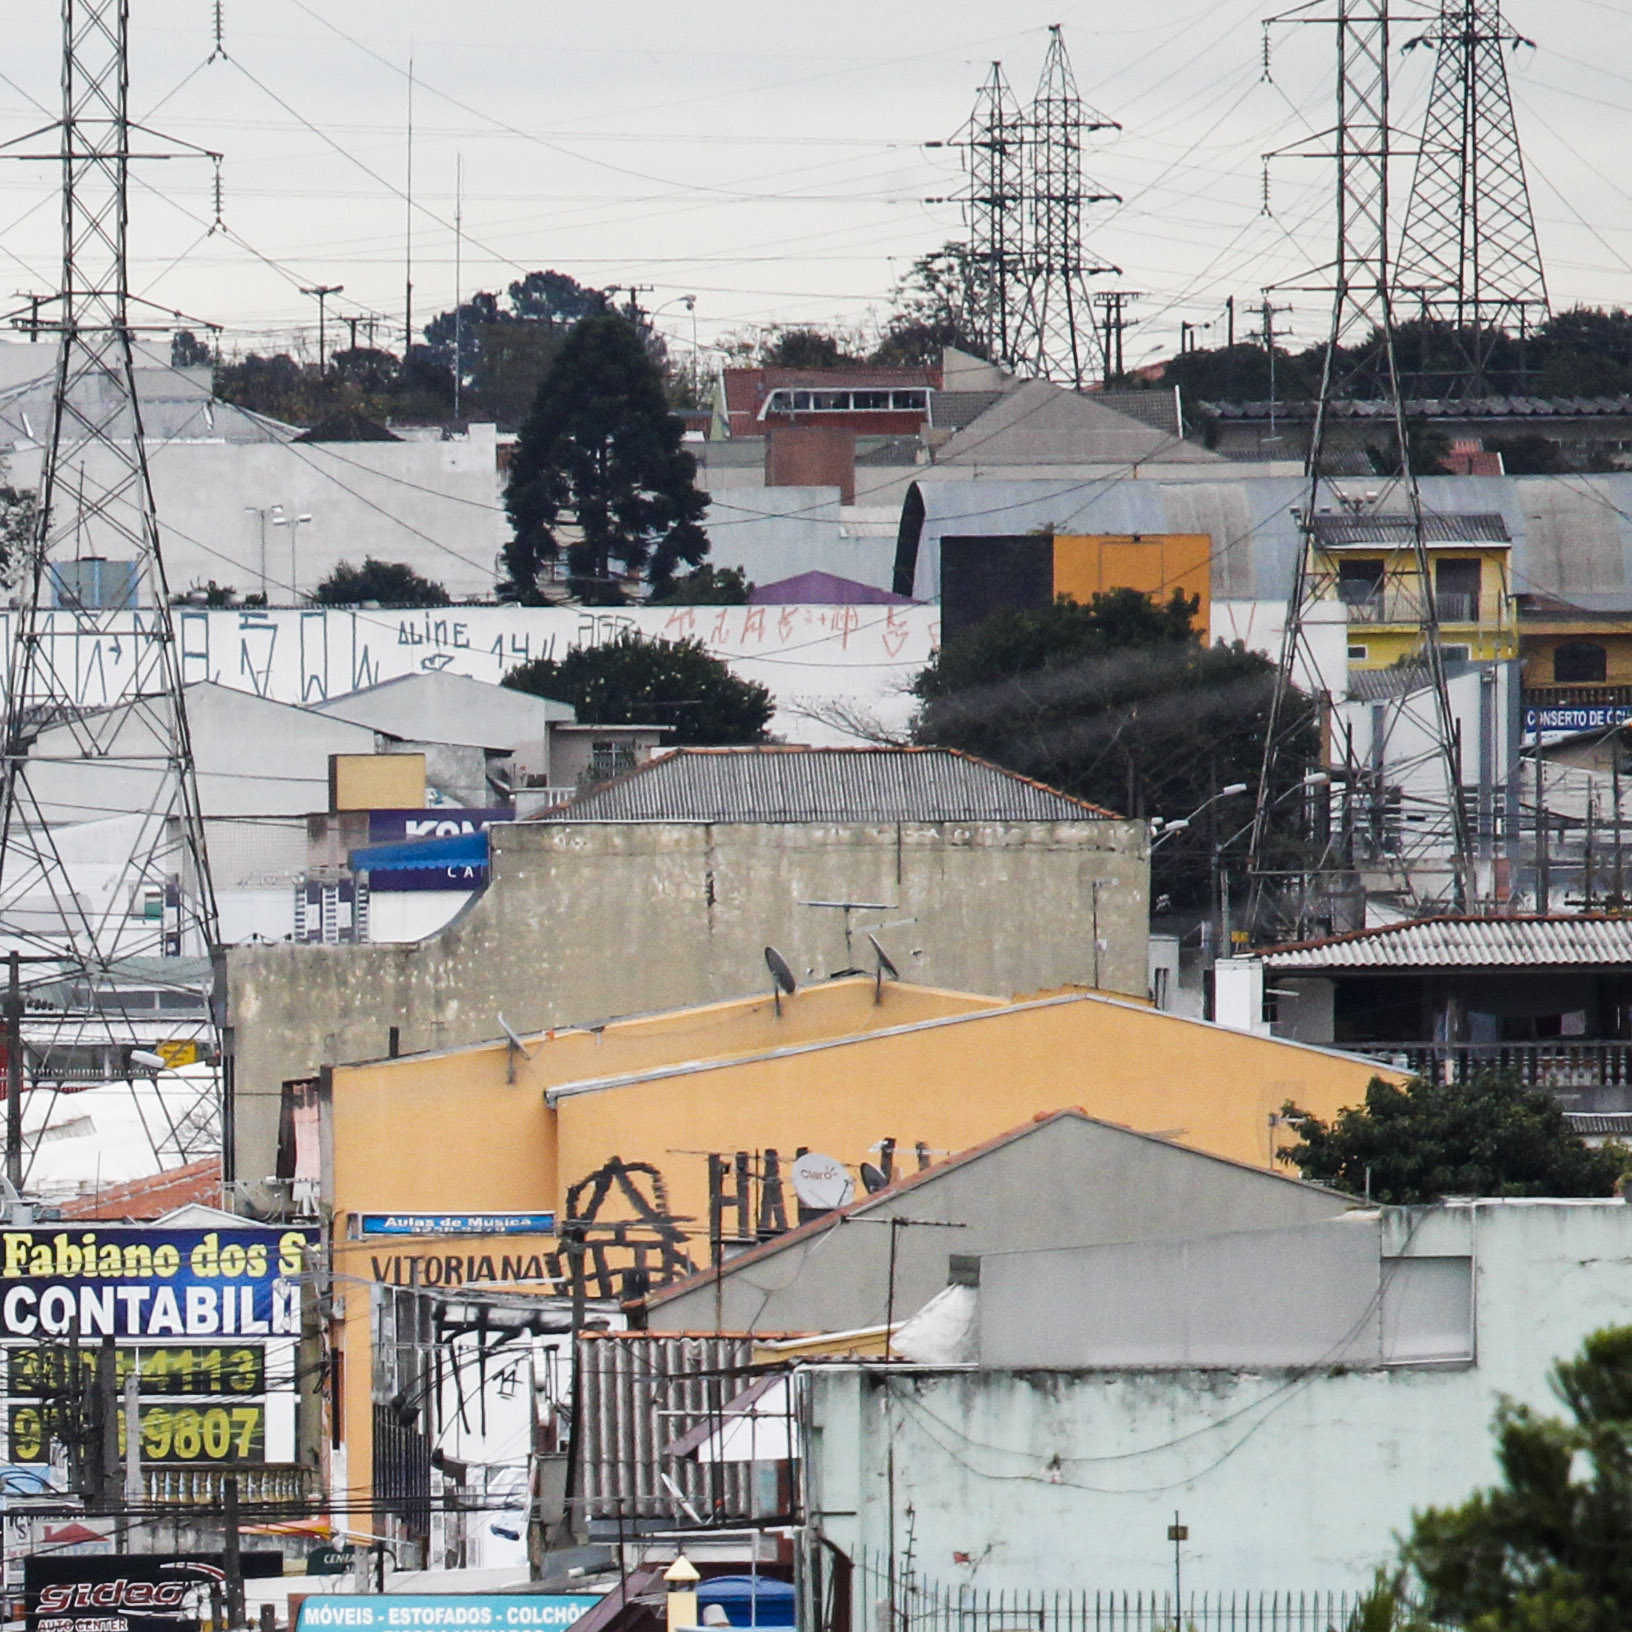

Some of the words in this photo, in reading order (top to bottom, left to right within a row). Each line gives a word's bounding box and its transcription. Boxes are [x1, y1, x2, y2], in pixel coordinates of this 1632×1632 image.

[799, 1167, 834, 1181] Claro
[384, 1216, 434, 1227] Aulas
[439, 1216, 462, 1227] de
[2, 1231, 180, 1279] Fabiano
[190, 1232, 268, 1279] dos
[370, 1255, 545, 1286] VITORIANA
[304, 1603, 374, 1626] MÓVEIS
[388, 1606, 492, 1625] ESTOFADOS
[37, 1618, 74, 1632] AUTO
[75, 1617, 129, 1632] CENTER
